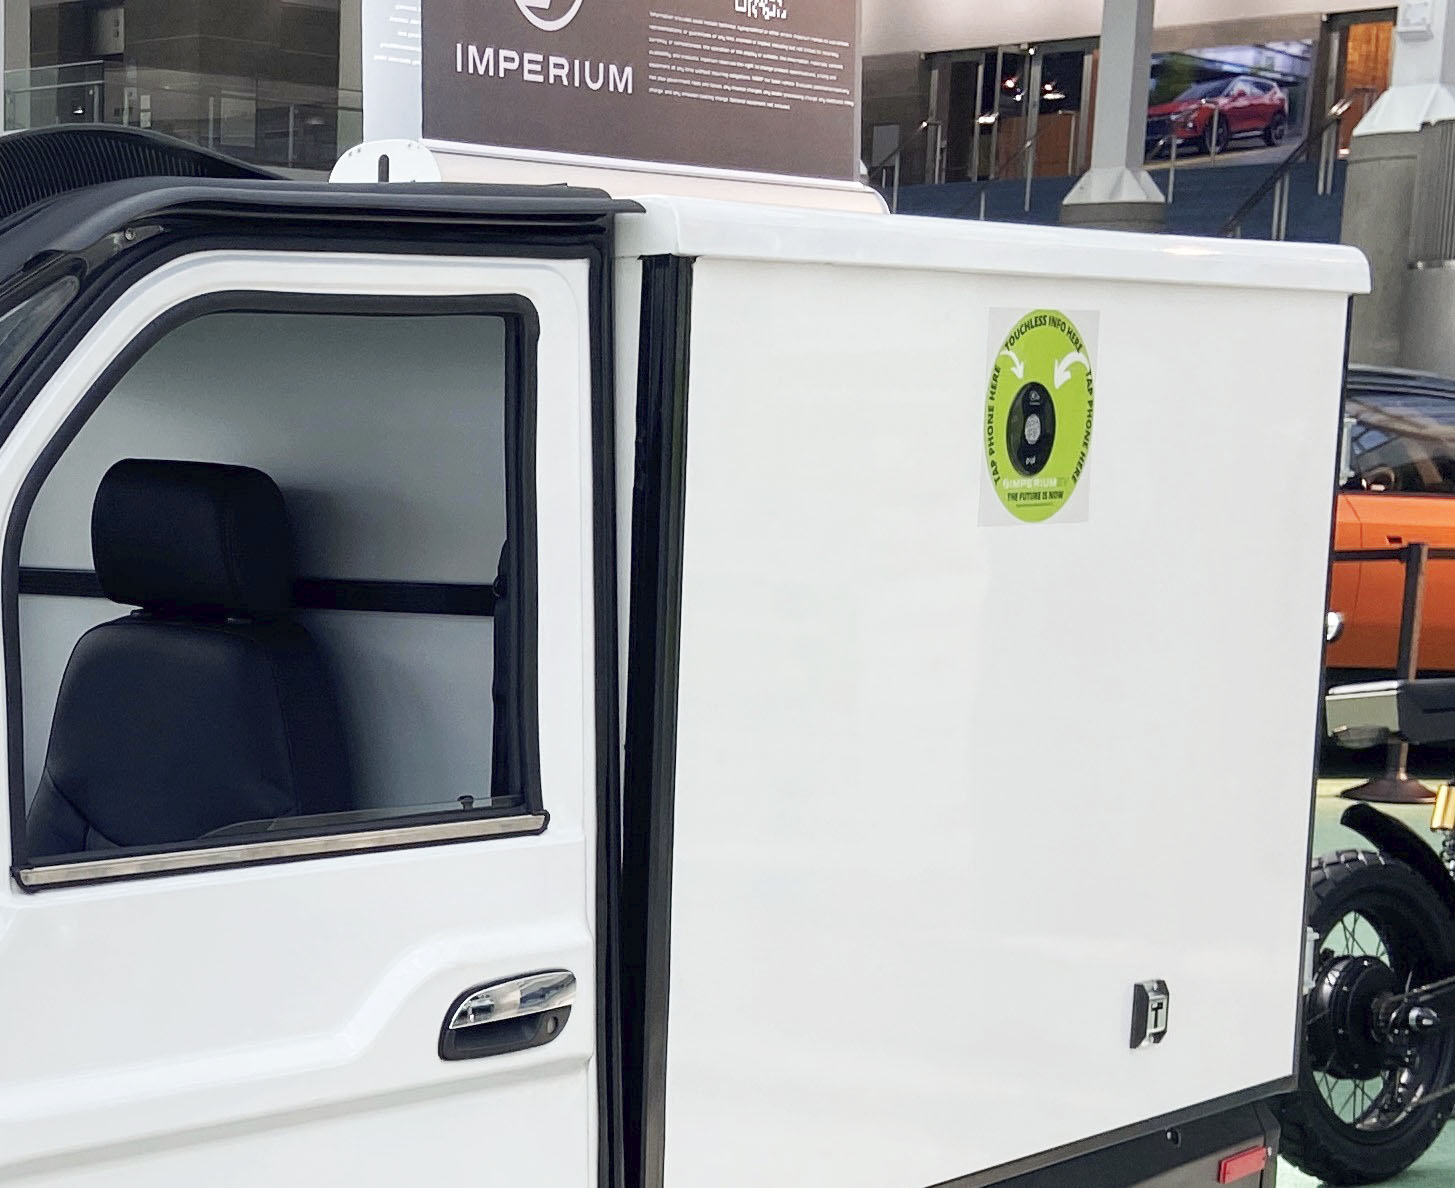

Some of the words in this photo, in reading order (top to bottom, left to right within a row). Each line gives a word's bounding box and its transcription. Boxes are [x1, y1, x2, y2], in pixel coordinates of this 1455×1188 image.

[455, 43, 633, 95] IMPERIUM
[1005, 315, 1047, 351] TOUCHLESS
[1048, 315, 1067, 332] INFO
[1067, 325, 1083, 353] HERE
[989, 365, 1001, 401] HERE
[1085, 369, 1093, 396] TAP
[987, 405, 995, 457] PHONE
[1083, 400, 1093, 449] PHONE
[990, 460, 1001, 486] TAP
[1071, 450, 1086, 484] HERE
[1007, 492, 1018, 501] THE
[1019, 491, 1041, 501] FUTURE
[1042, 491, 1048, 500] IS
[1048, 490, 1065, 500] NOW
